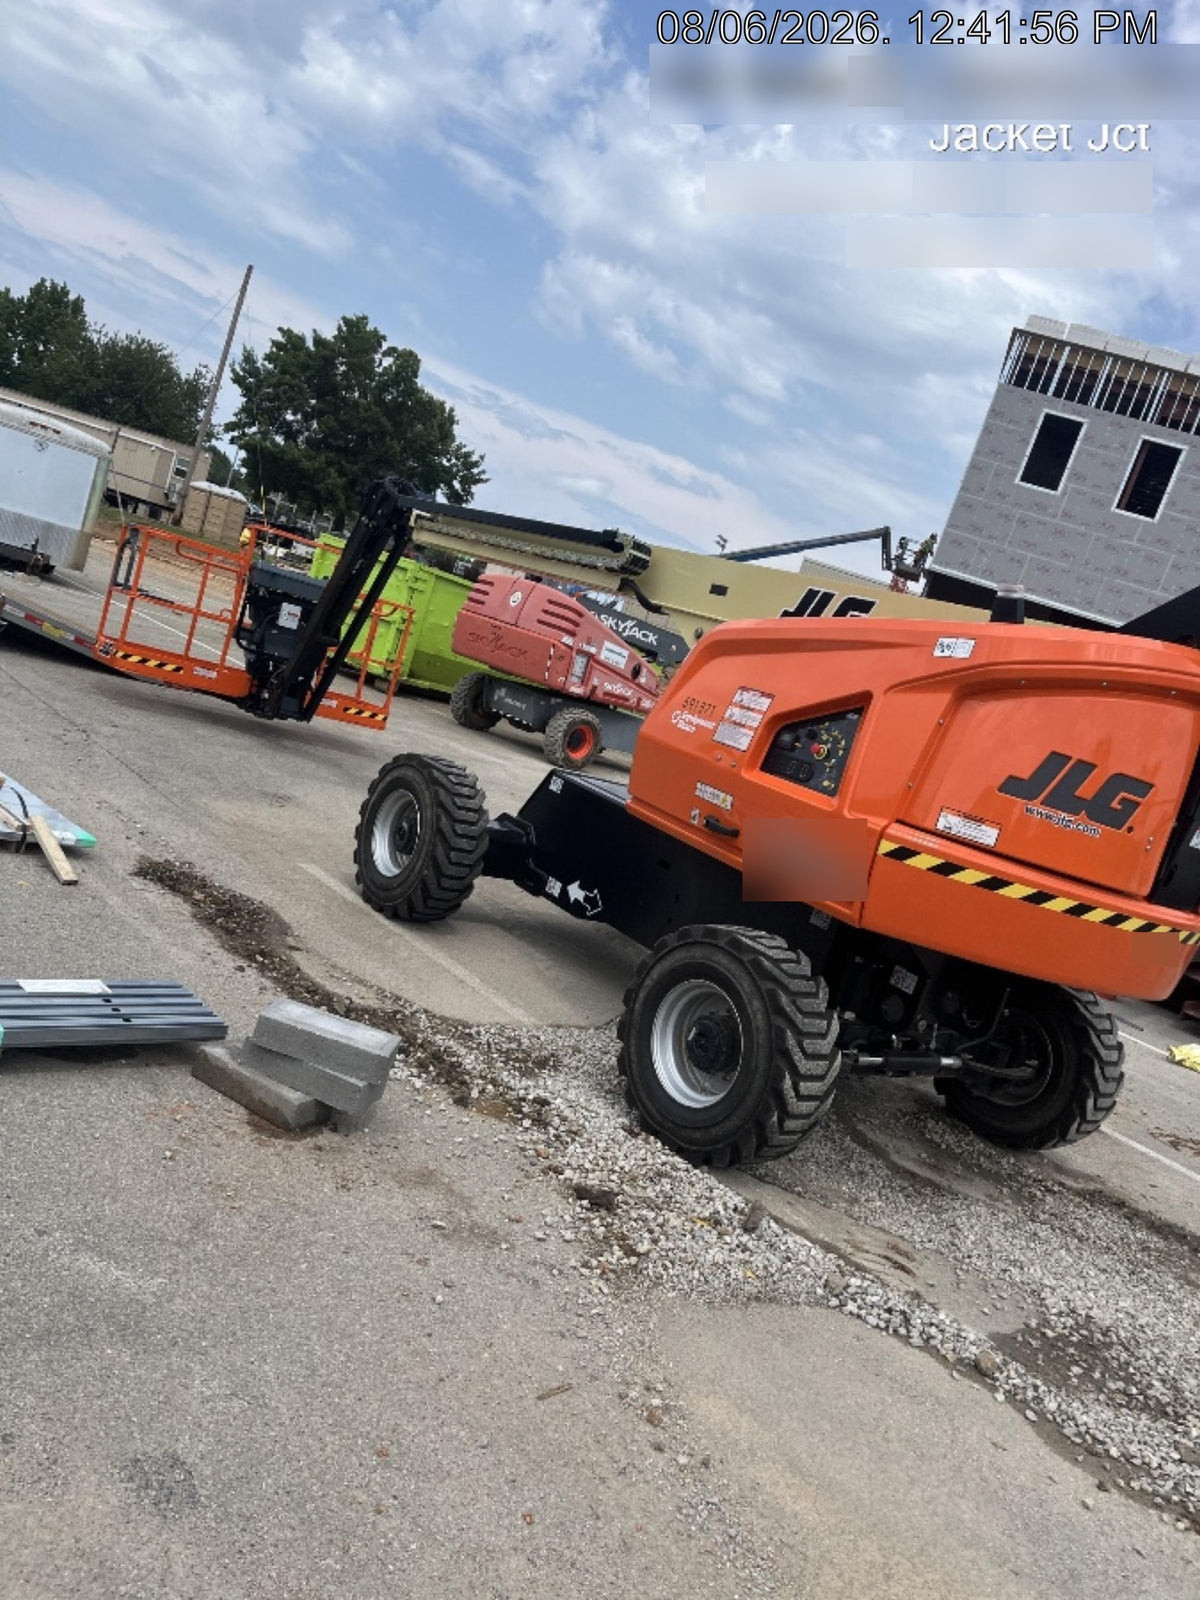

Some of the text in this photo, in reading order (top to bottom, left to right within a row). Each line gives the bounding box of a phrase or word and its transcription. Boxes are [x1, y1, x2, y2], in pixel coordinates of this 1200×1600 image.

[600, 613, 659, 646] SKYJACK
[997, 750, 1155, 831] JLG
[1024, 804, 1101, 838] www.jlg.com
